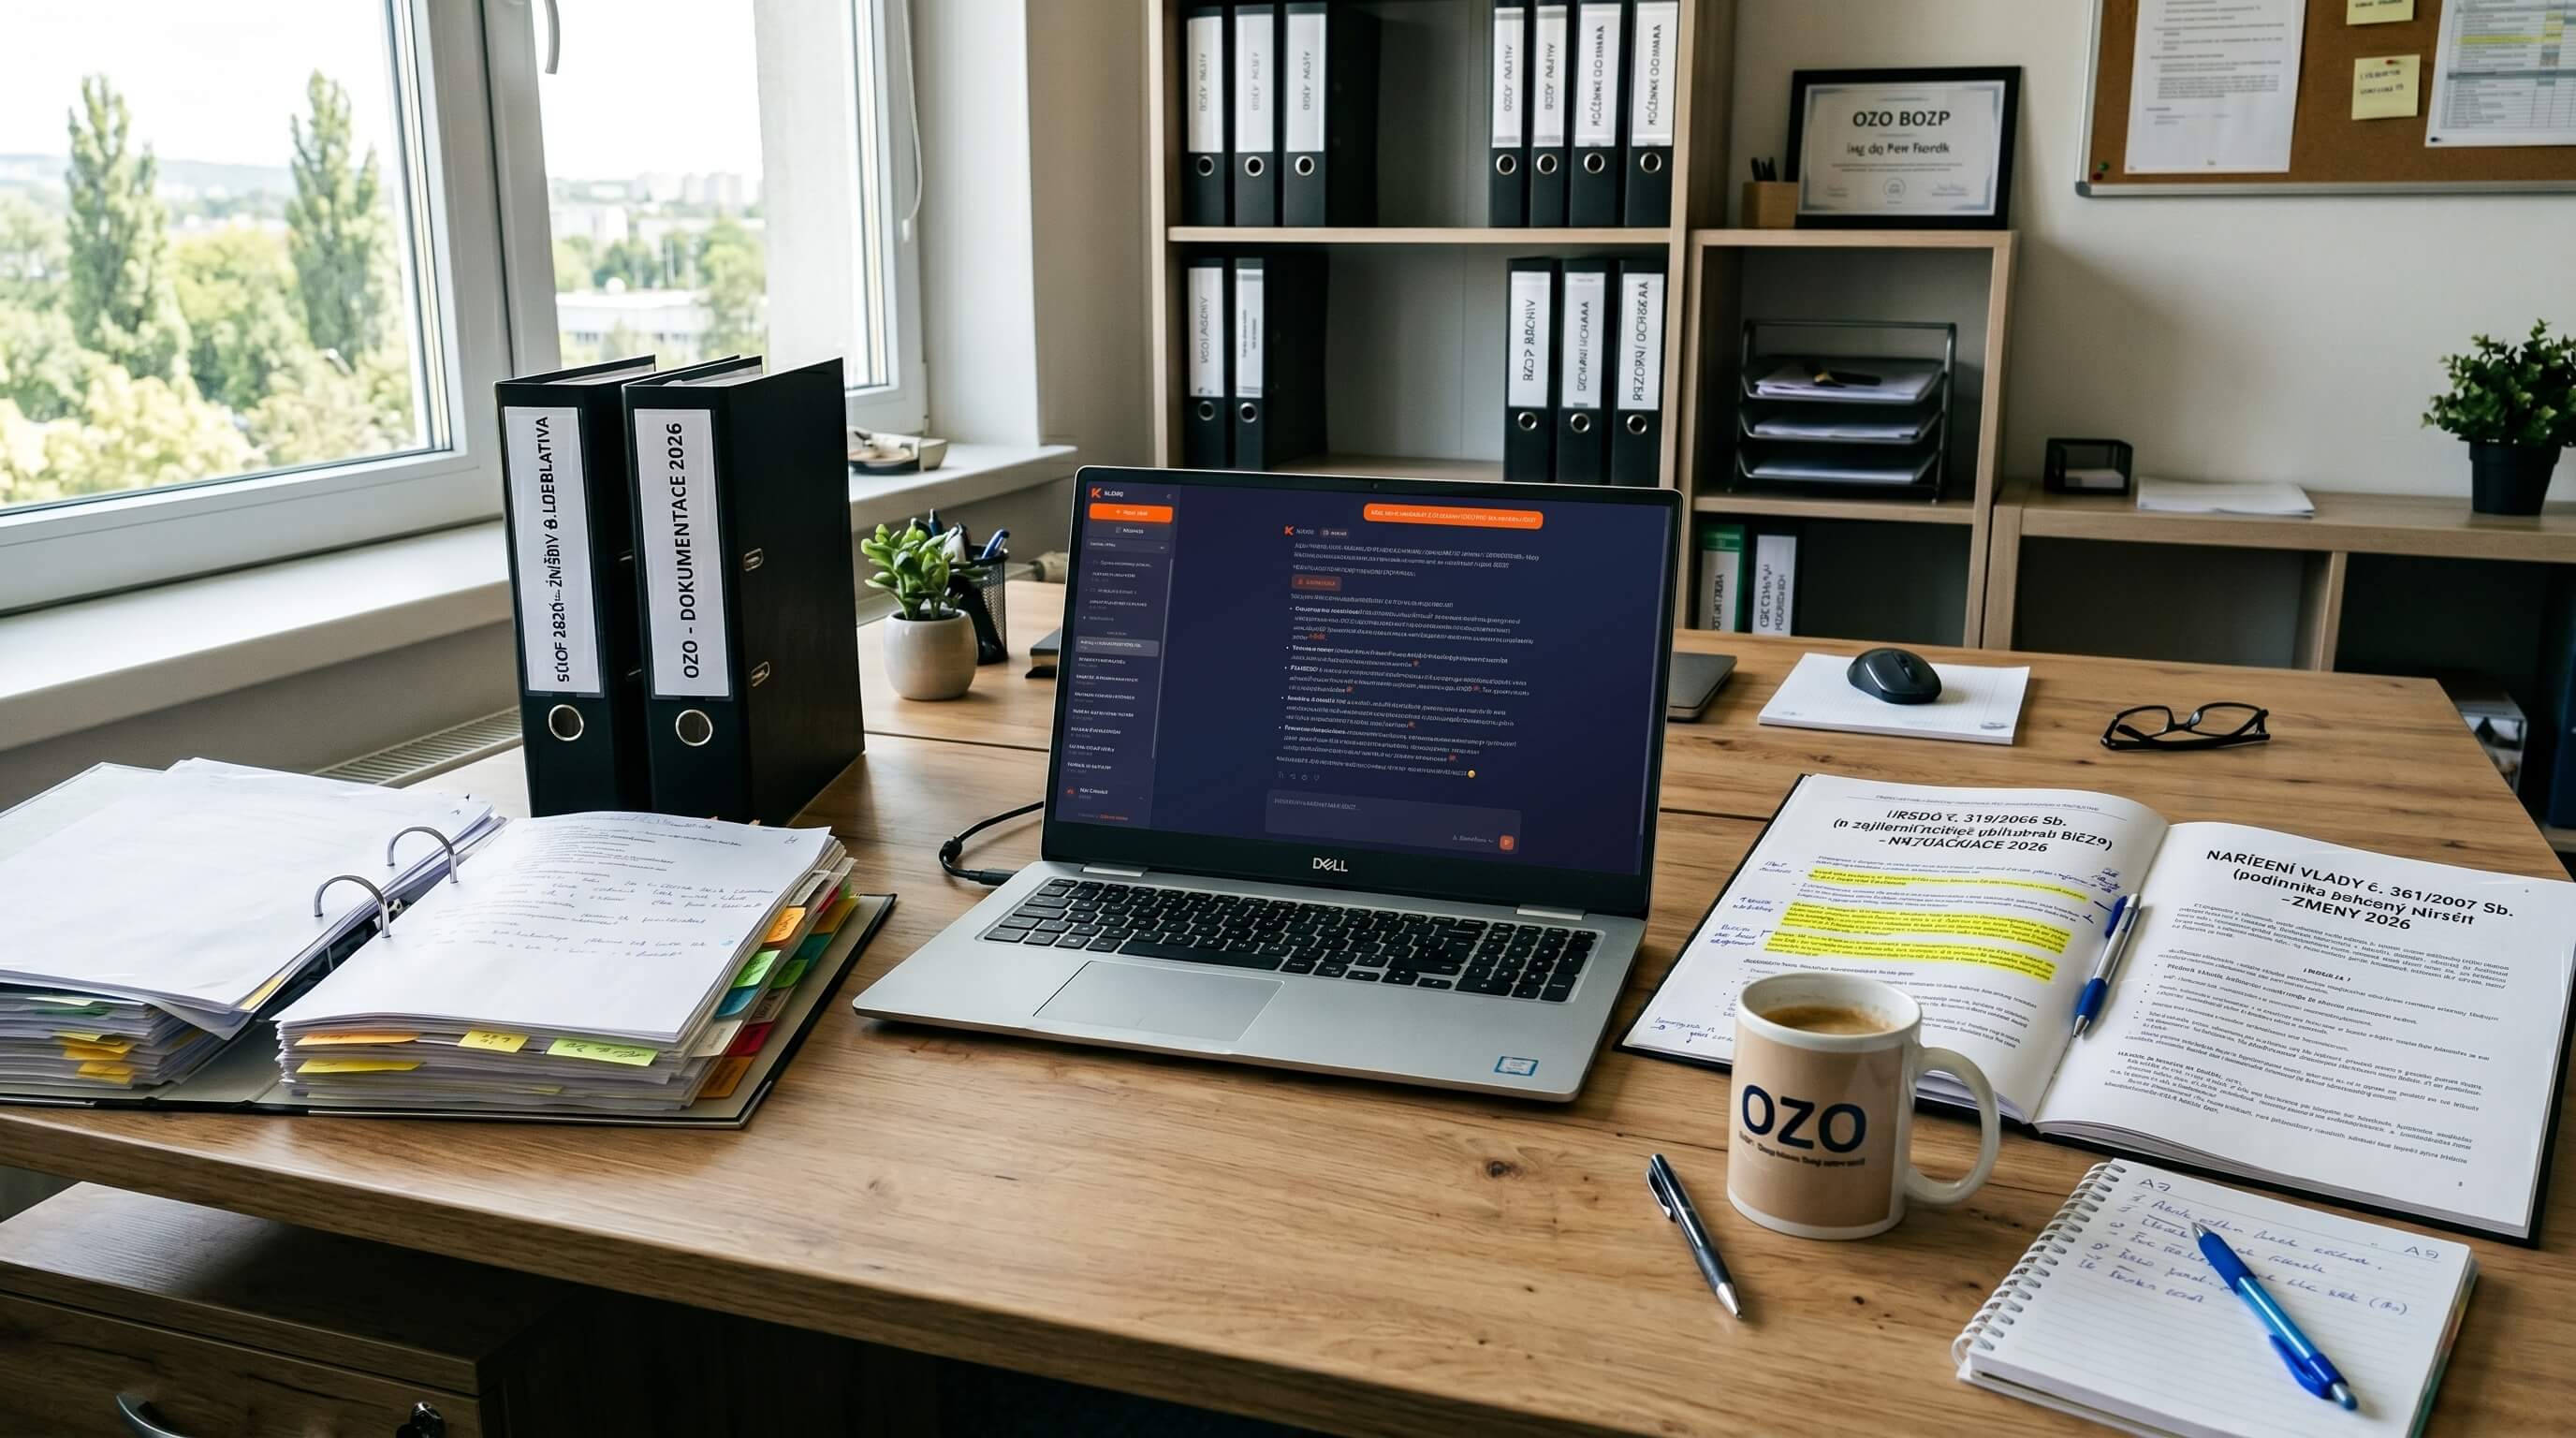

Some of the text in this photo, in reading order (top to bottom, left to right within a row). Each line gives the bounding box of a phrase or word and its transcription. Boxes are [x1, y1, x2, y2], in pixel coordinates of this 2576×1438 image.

[1852, 110, 1951, 127] OZO BOZP
[666, 422, 684, 471] 2026
[669, 476, 696, 621] DOKUMENTACE
[682, 640, 700, 679] OZO
[2042, 816, 2067, 827] Sb.
[2007, 841, 2048, 853] 2026
[1312, 858, 1348, 873] DELL
[2301, 867, 2364, 889] VLADY
[2390, 887, 2479, 910] 361/2007
[2482, 902, 2514, 917] Sb.
[2364, 912, 2411, 930] 2026
[1742, 1084, 1866, 1153] OZO
